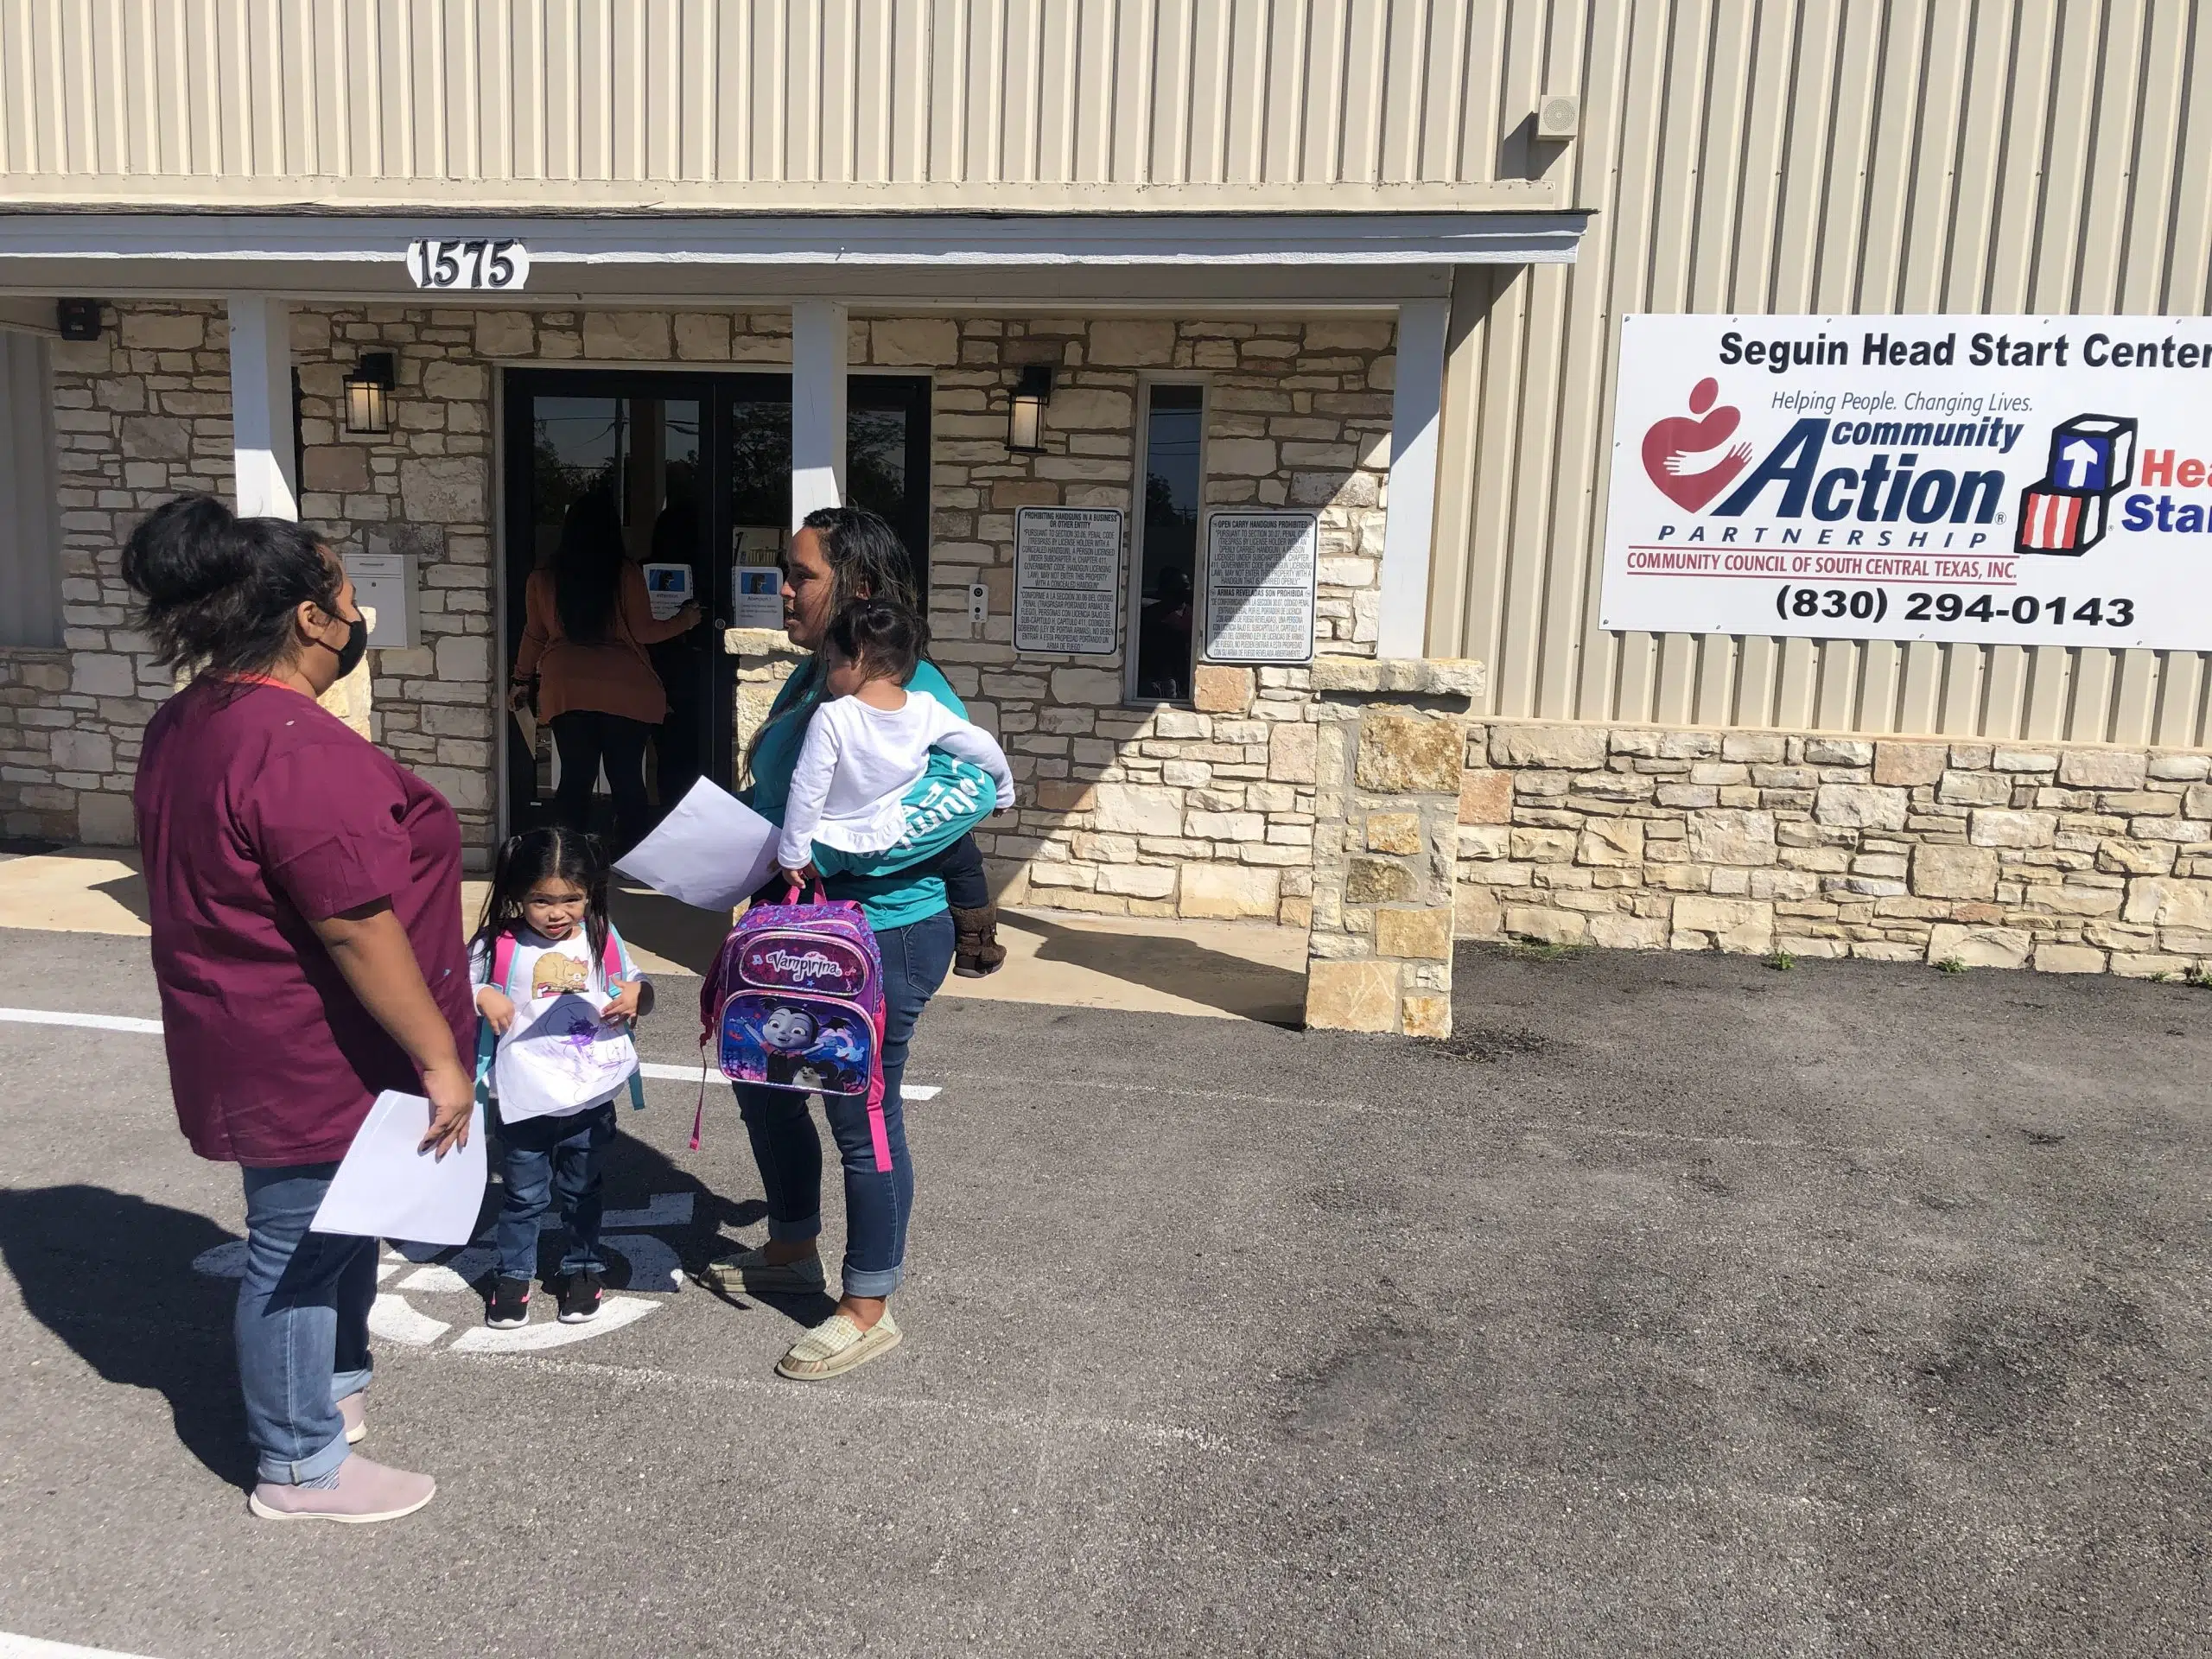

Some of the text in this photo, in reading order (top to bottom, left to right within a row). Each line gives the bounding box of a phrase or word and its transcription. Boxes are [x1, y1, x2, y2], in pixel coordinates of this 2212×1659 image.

[418, 238, 515, 288] 1575
[1719, 332, 1849, 374] Seguin
[1862, 332, 1956, 365] Head
[1969, 332, 2070, 366] Start
[1771, 391, 2033, 416] Helping People. Changing Lives.
[1831, 416, 2024, 454] community
[1708, 418, 2006, 524] Action
[2140, 448, 2212, 488] He
[2121, 493, 2212, 533] Sta
[1657, 524, 1987, 549] PARTNERSHIP
[1627, 552, 2017, 580] COMMUNITY COUNCIL OF SOUTH CENTRAL TEXAS, INC.
[1777, 584, 2135, 628] (830) 294-0143
[766, 950, 842, 982] Vampirina
